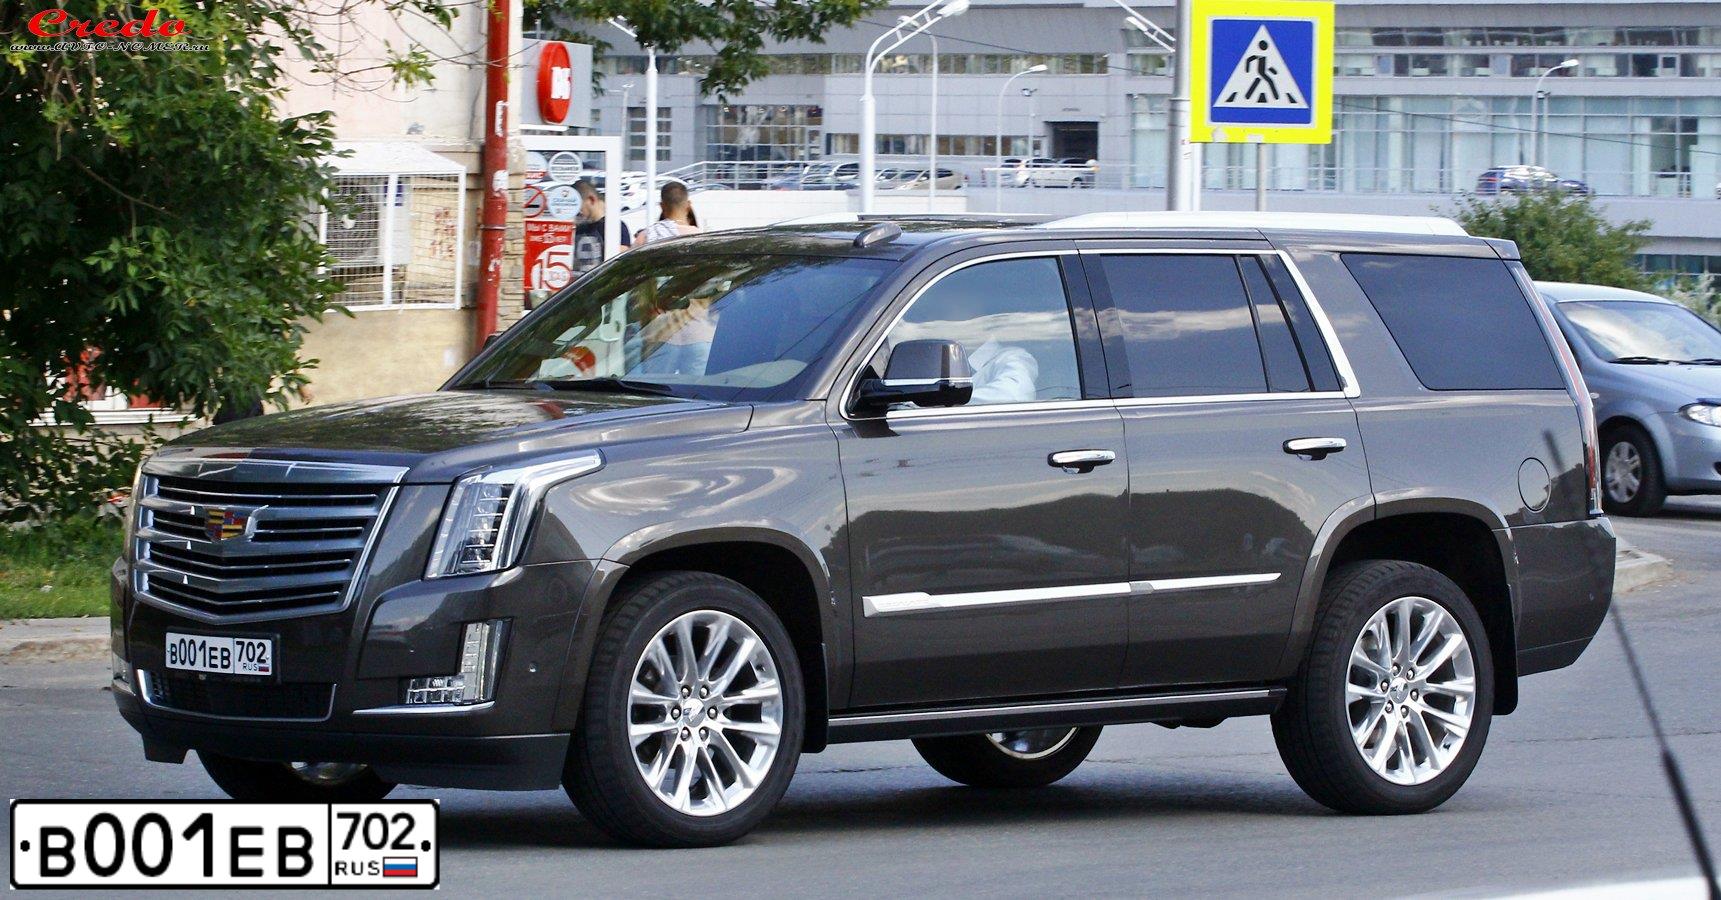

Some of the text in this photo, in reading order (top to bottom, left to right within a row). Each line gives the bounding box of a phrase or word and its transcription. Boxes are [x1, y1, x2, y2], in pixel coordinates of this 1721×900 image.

[531, 251, 571, 290] 15
[235, 640, 267, 664] 702
[242, 662, 258, 672] RUS
